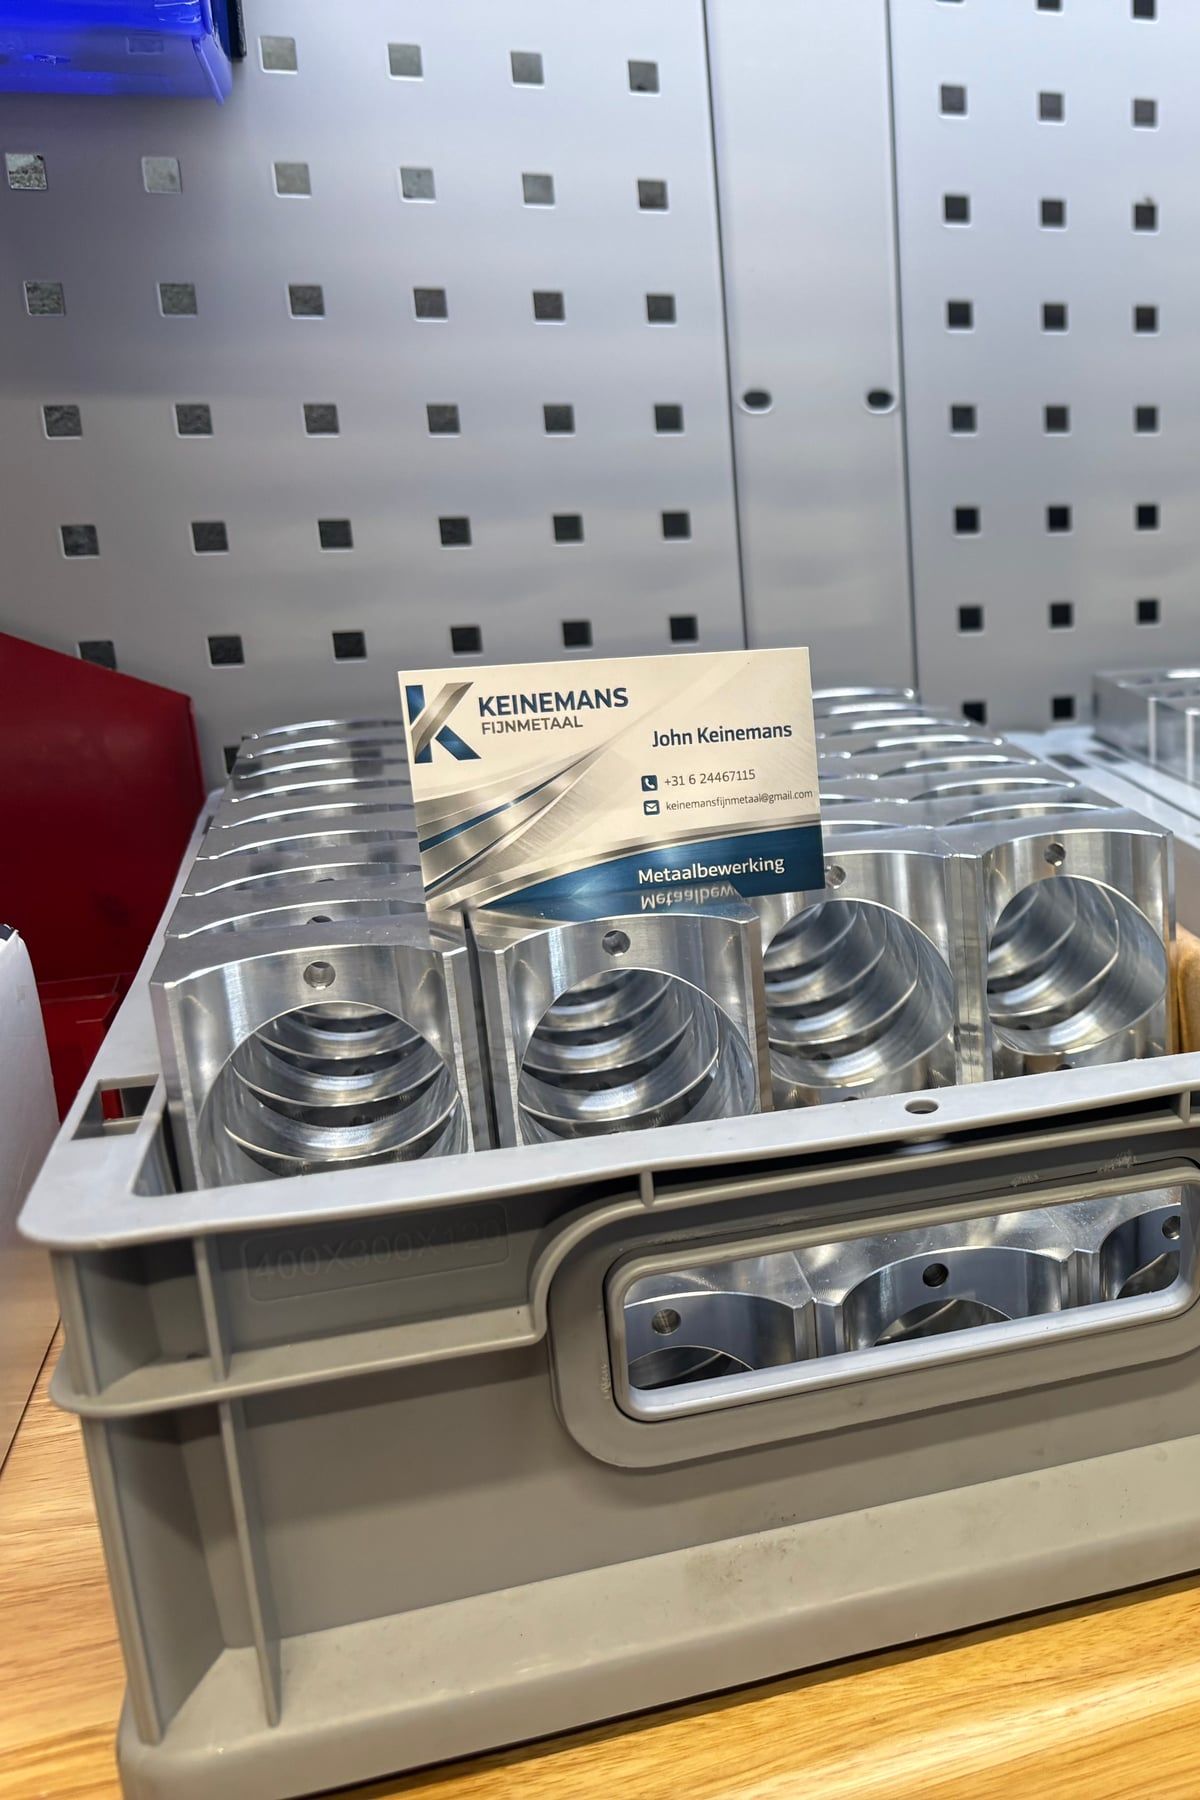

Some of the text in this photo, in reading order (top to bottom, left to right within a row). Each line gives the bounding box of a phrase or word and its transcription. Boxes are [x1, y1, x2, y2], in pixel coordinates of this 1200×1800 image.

[478, 687, 629, 717] KEINEMANS
[481, 715, 584, 735] FIJNMETAAL
[652, 724, 793, 748] John Keinemans
[664, 769, 756, 788] +31 6 24467115
[666, 789, 813, 811] keinemansfijnmetaal@gmail.com
[638, 857, 785, 884] Metaalbewerking
